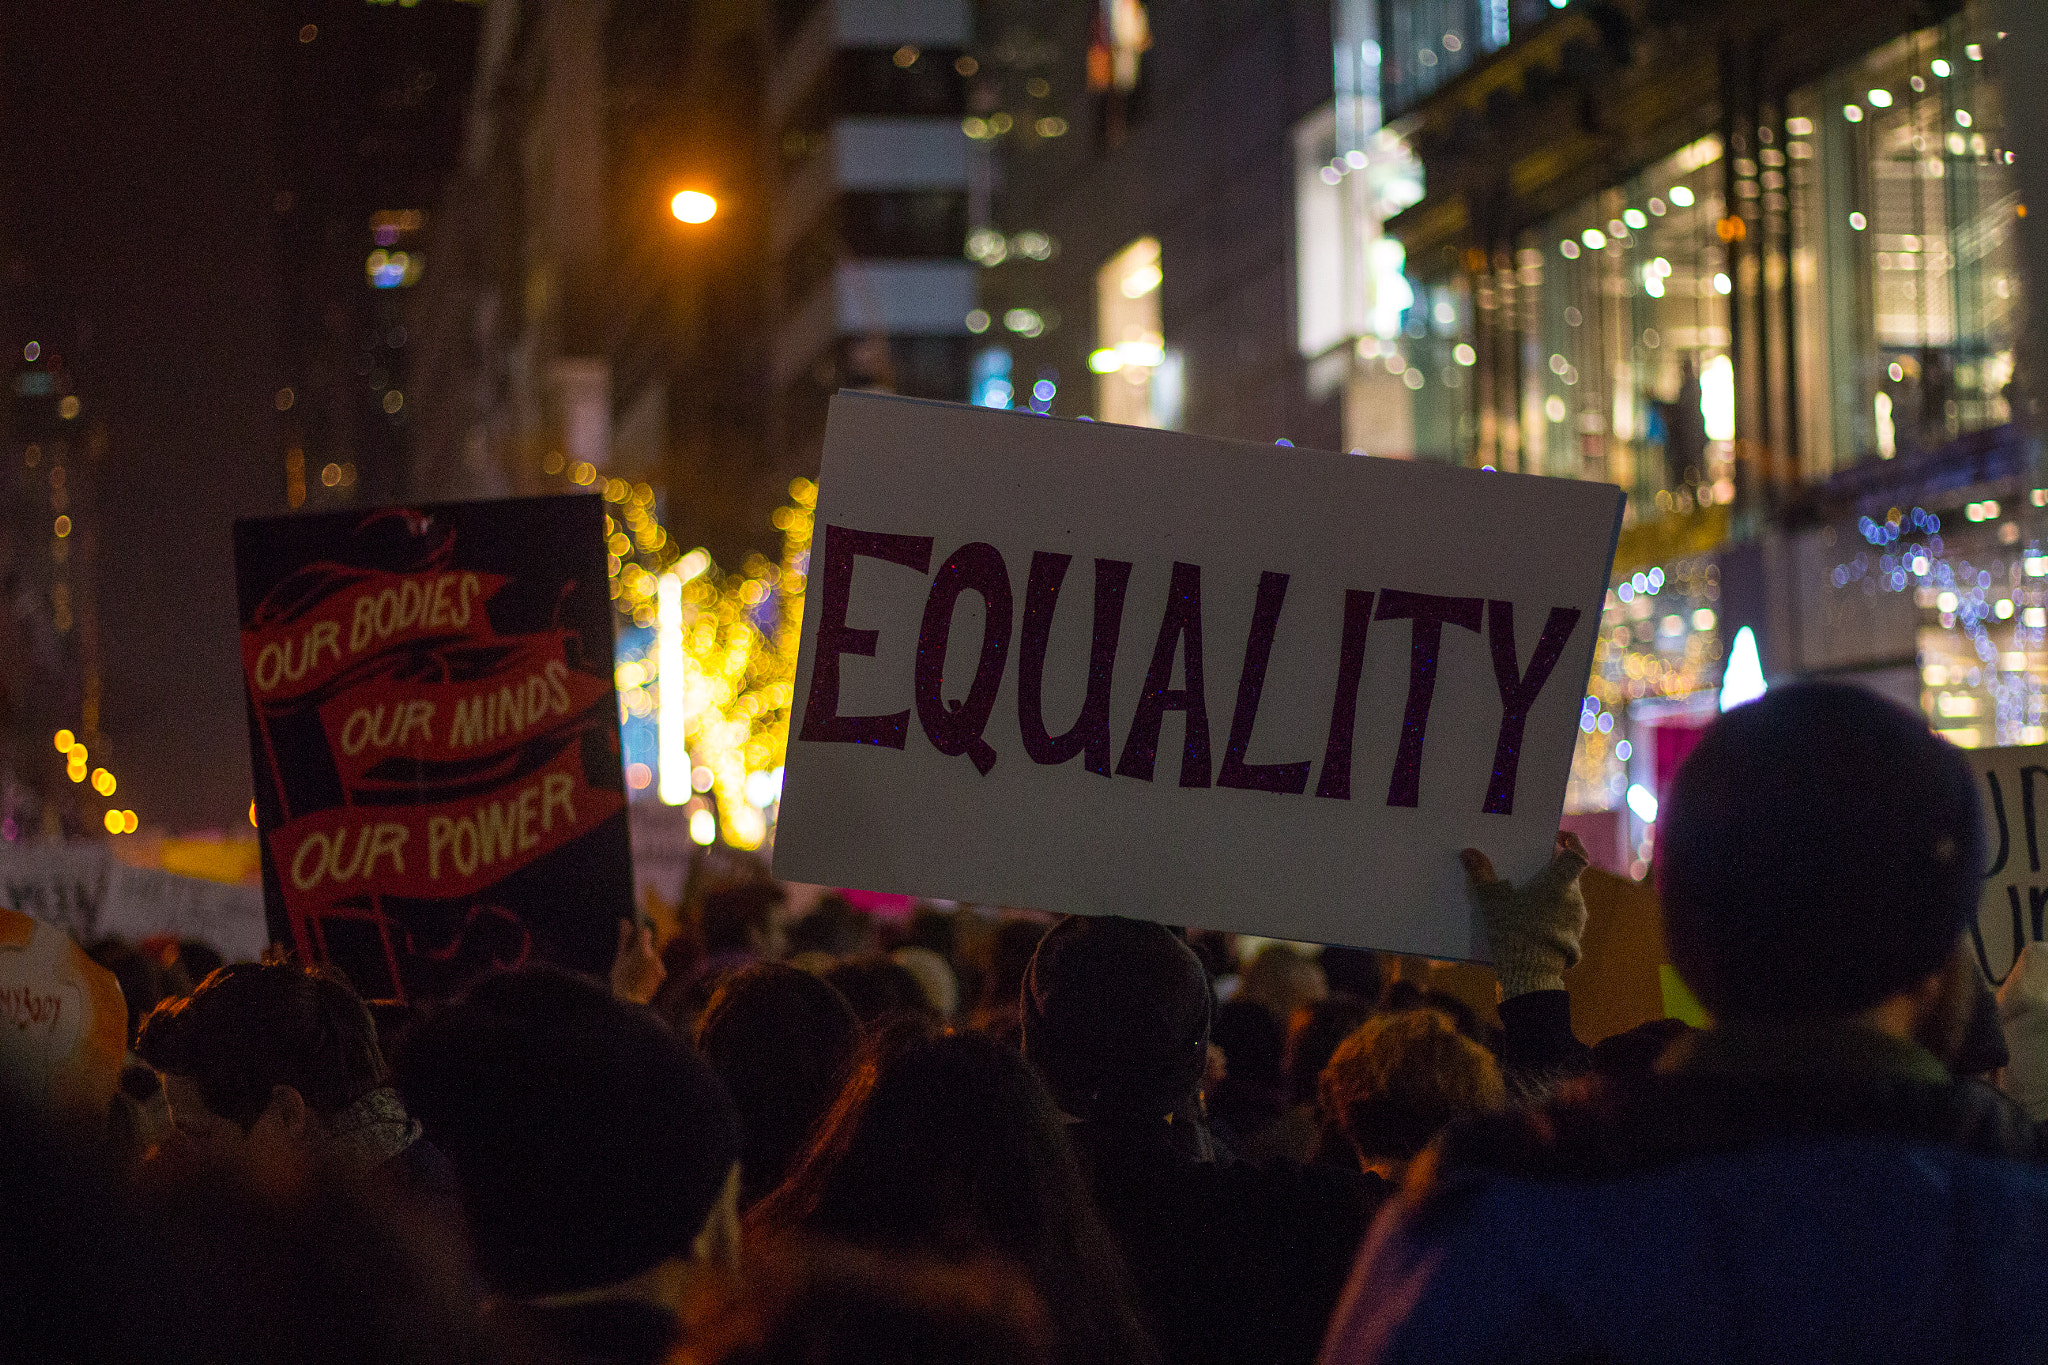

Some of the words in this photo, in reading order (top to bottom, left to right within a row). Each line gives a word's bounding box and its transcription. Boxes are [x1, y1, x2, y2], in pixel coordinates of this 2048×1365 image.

[255, 620, 342, 691] OUR
[348, 573, 480, 653] BODIES
[799, 525, 1580, 814] EQUALITY
[341, 700, 436, 756] OUR
[450, 660, 570, 748] MINDS
[291, 822, 410, 890] OUR
[429, 773, 576, 880] POWER
